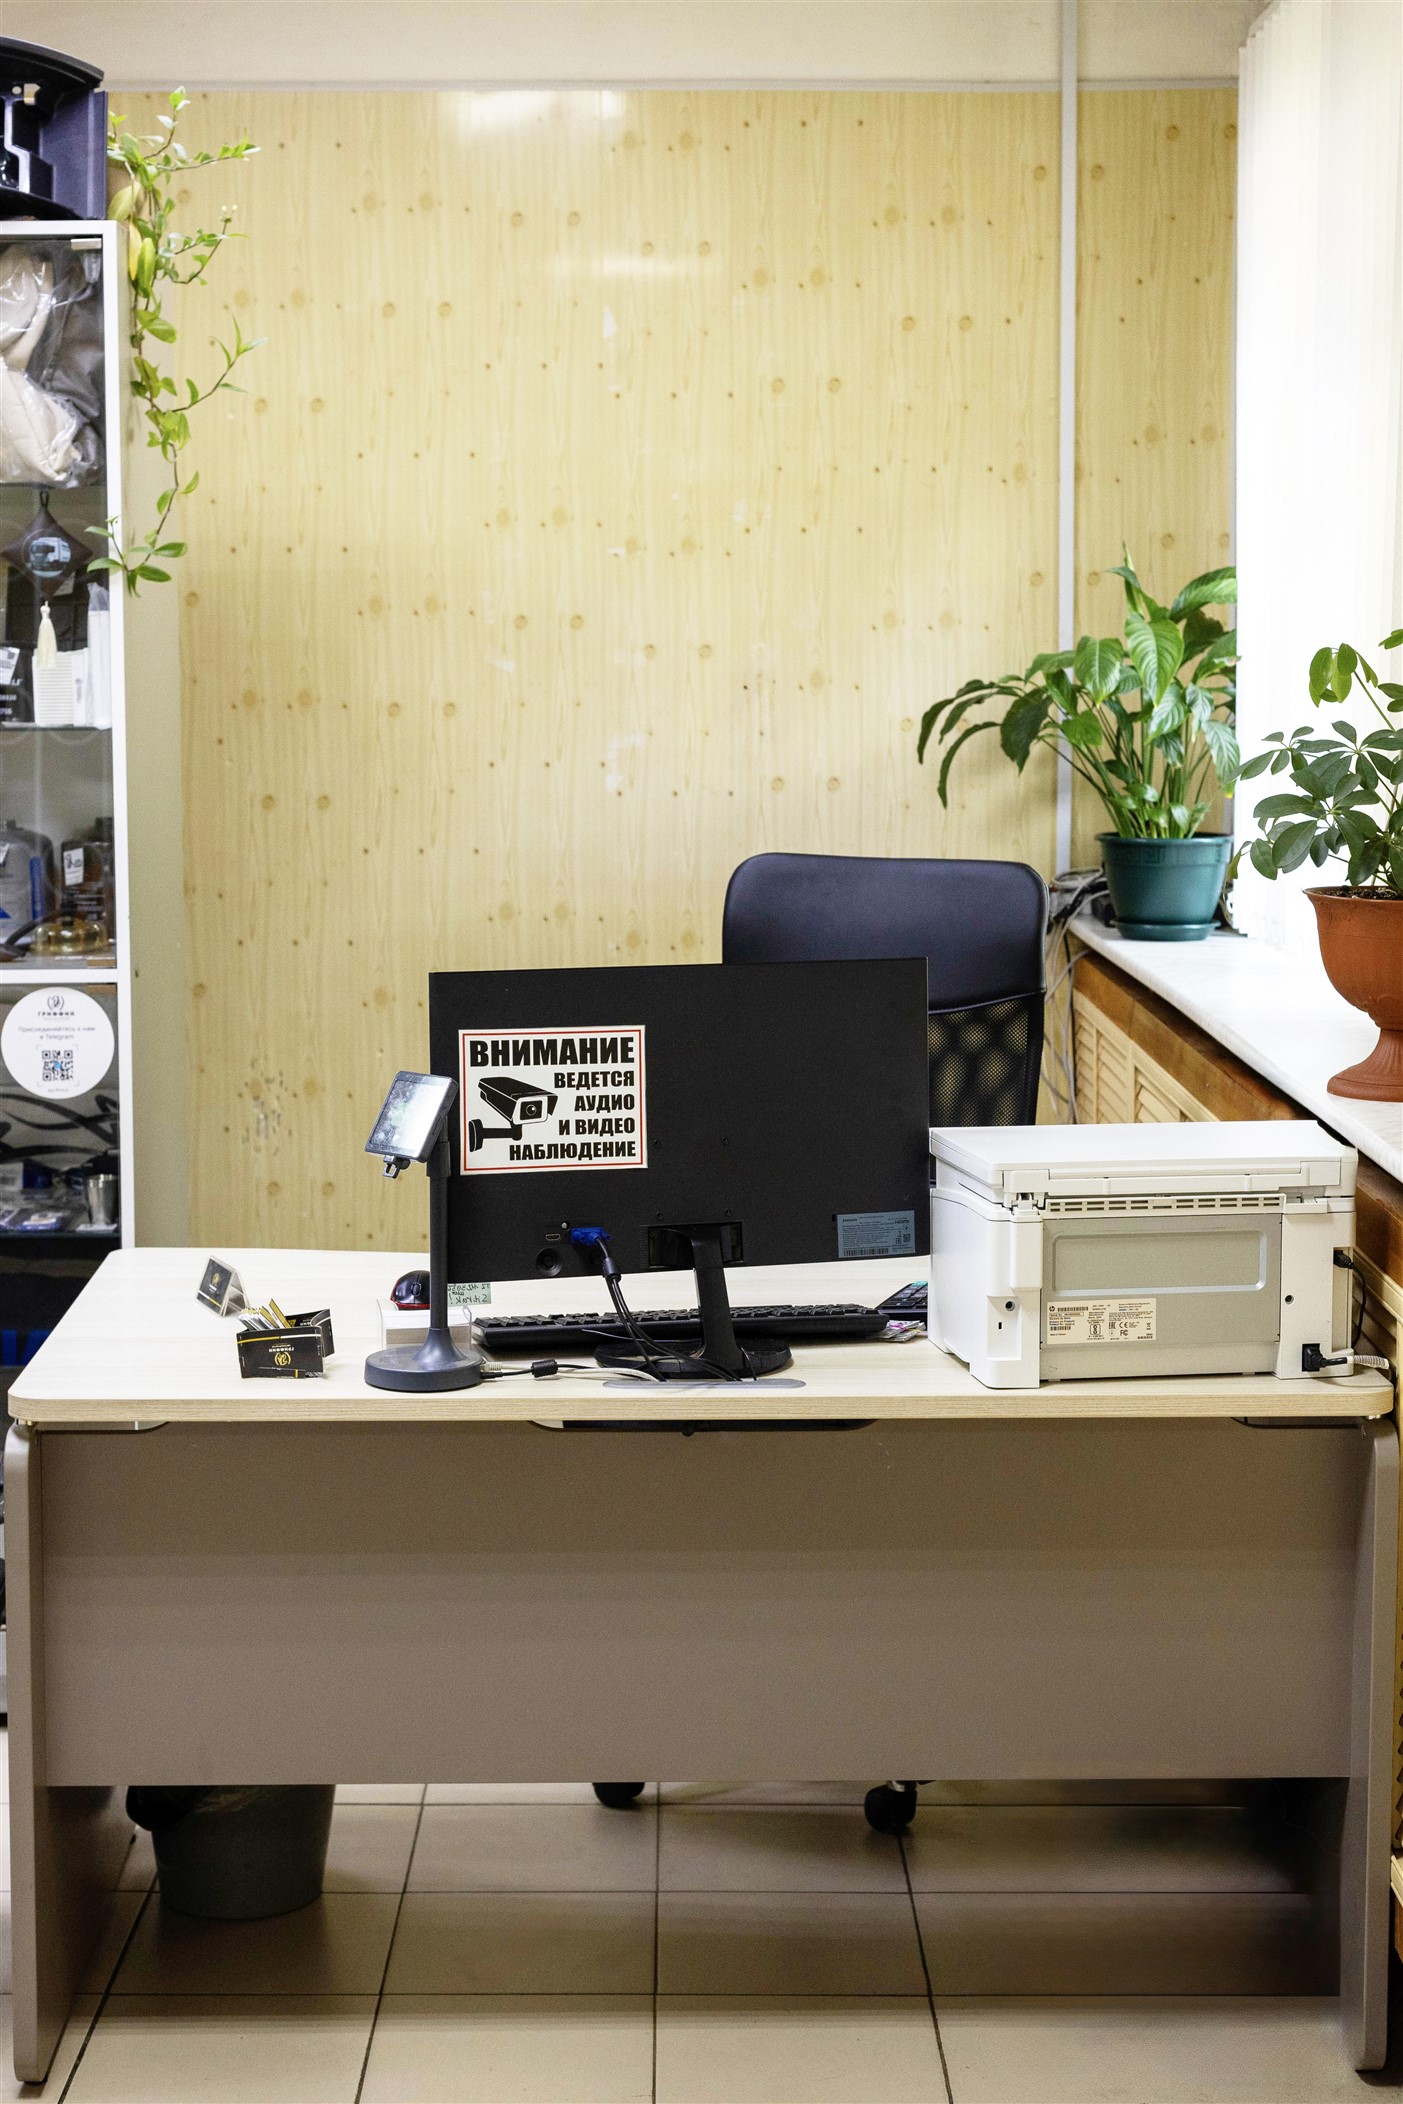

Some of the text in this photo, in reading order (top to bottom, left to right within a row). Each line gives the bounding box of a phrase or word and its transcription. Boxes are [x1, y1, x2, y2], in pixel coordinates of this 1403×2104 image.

[469, 1037, 635, 1067] ВНИМАНИЕ
[554, 1070, 635, 1090] ВЕДЕТСЯ
[574, 1094, 635, 1114] АУДИО
[558, 1117, 636, 1137] И ВИДЕО
[509, 1141, 636, 1161] НАБЛЮДЕНИЕ
